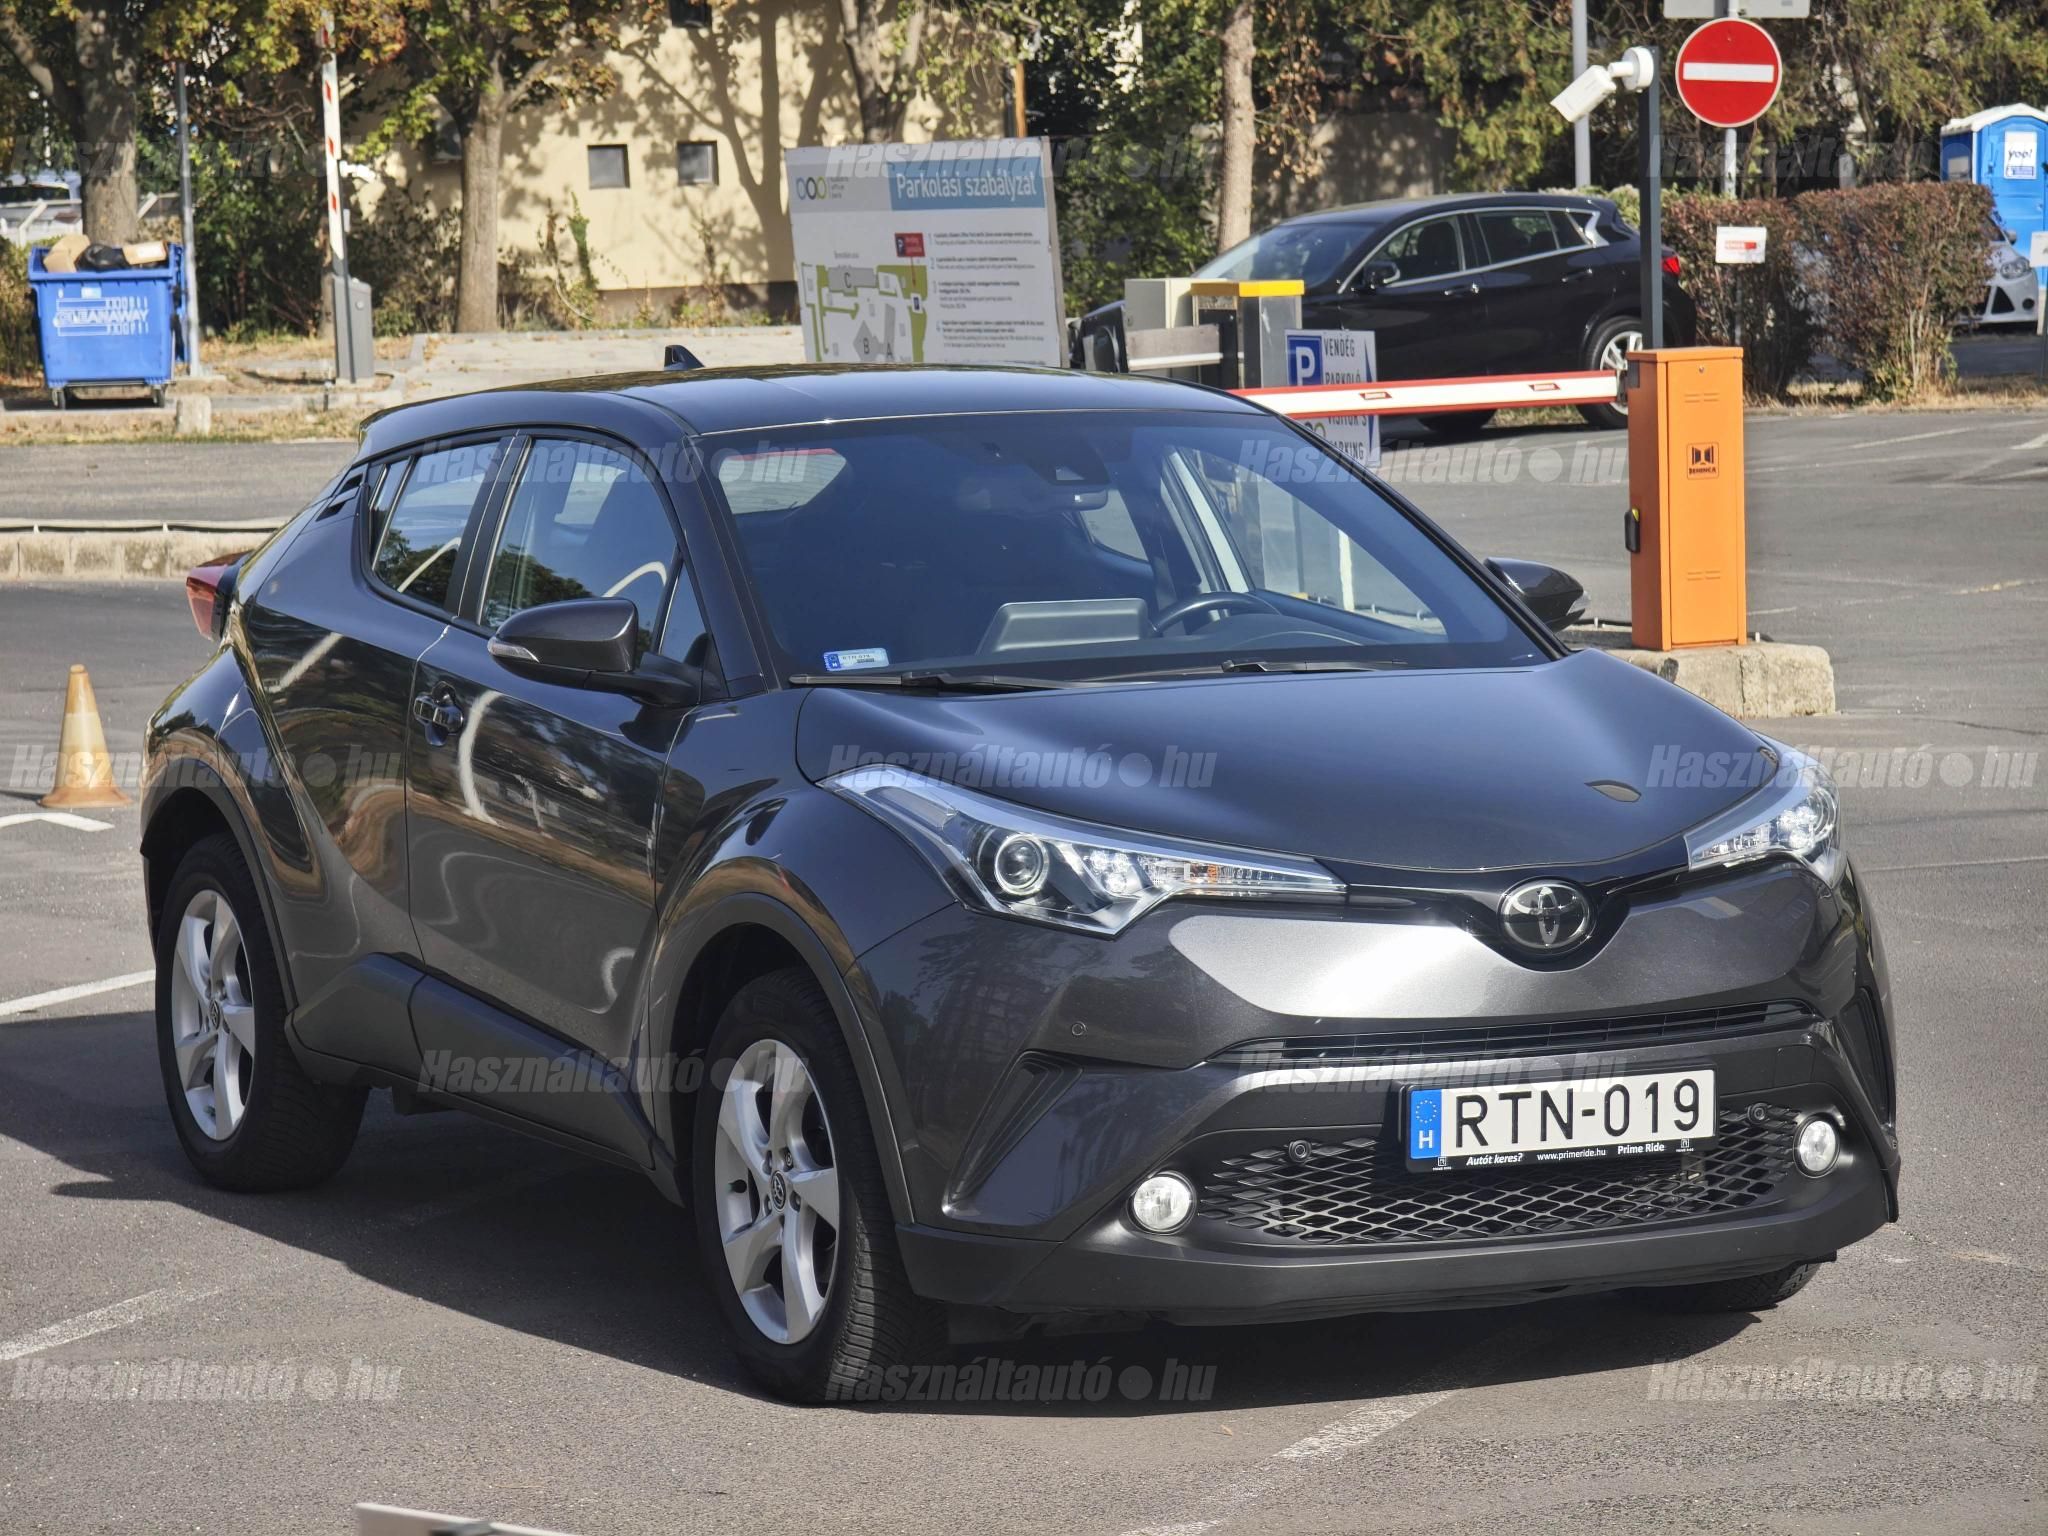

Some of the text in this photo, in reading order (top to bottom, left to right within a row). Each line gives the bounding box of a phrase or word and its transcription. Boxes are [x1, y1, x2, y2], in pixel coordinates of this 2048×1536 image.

[896, 168, 1037, 201] Parkolási szabályzat
[863, 337, 870, 354] B
[1324, 333, 1355, 357] VENDÉG
[1456, 1078, 1700, 1148] RTN-019
[1418, 1129, 1433, 1149] H
[1537, 1148, 1606, 1161] www.primeride.hu
[1617, 1145, 1643, 1155] Prime
[1645, 1142, 1665, 1153] Ride
[1466, 1152, 1523, 1166] Autót keres?
